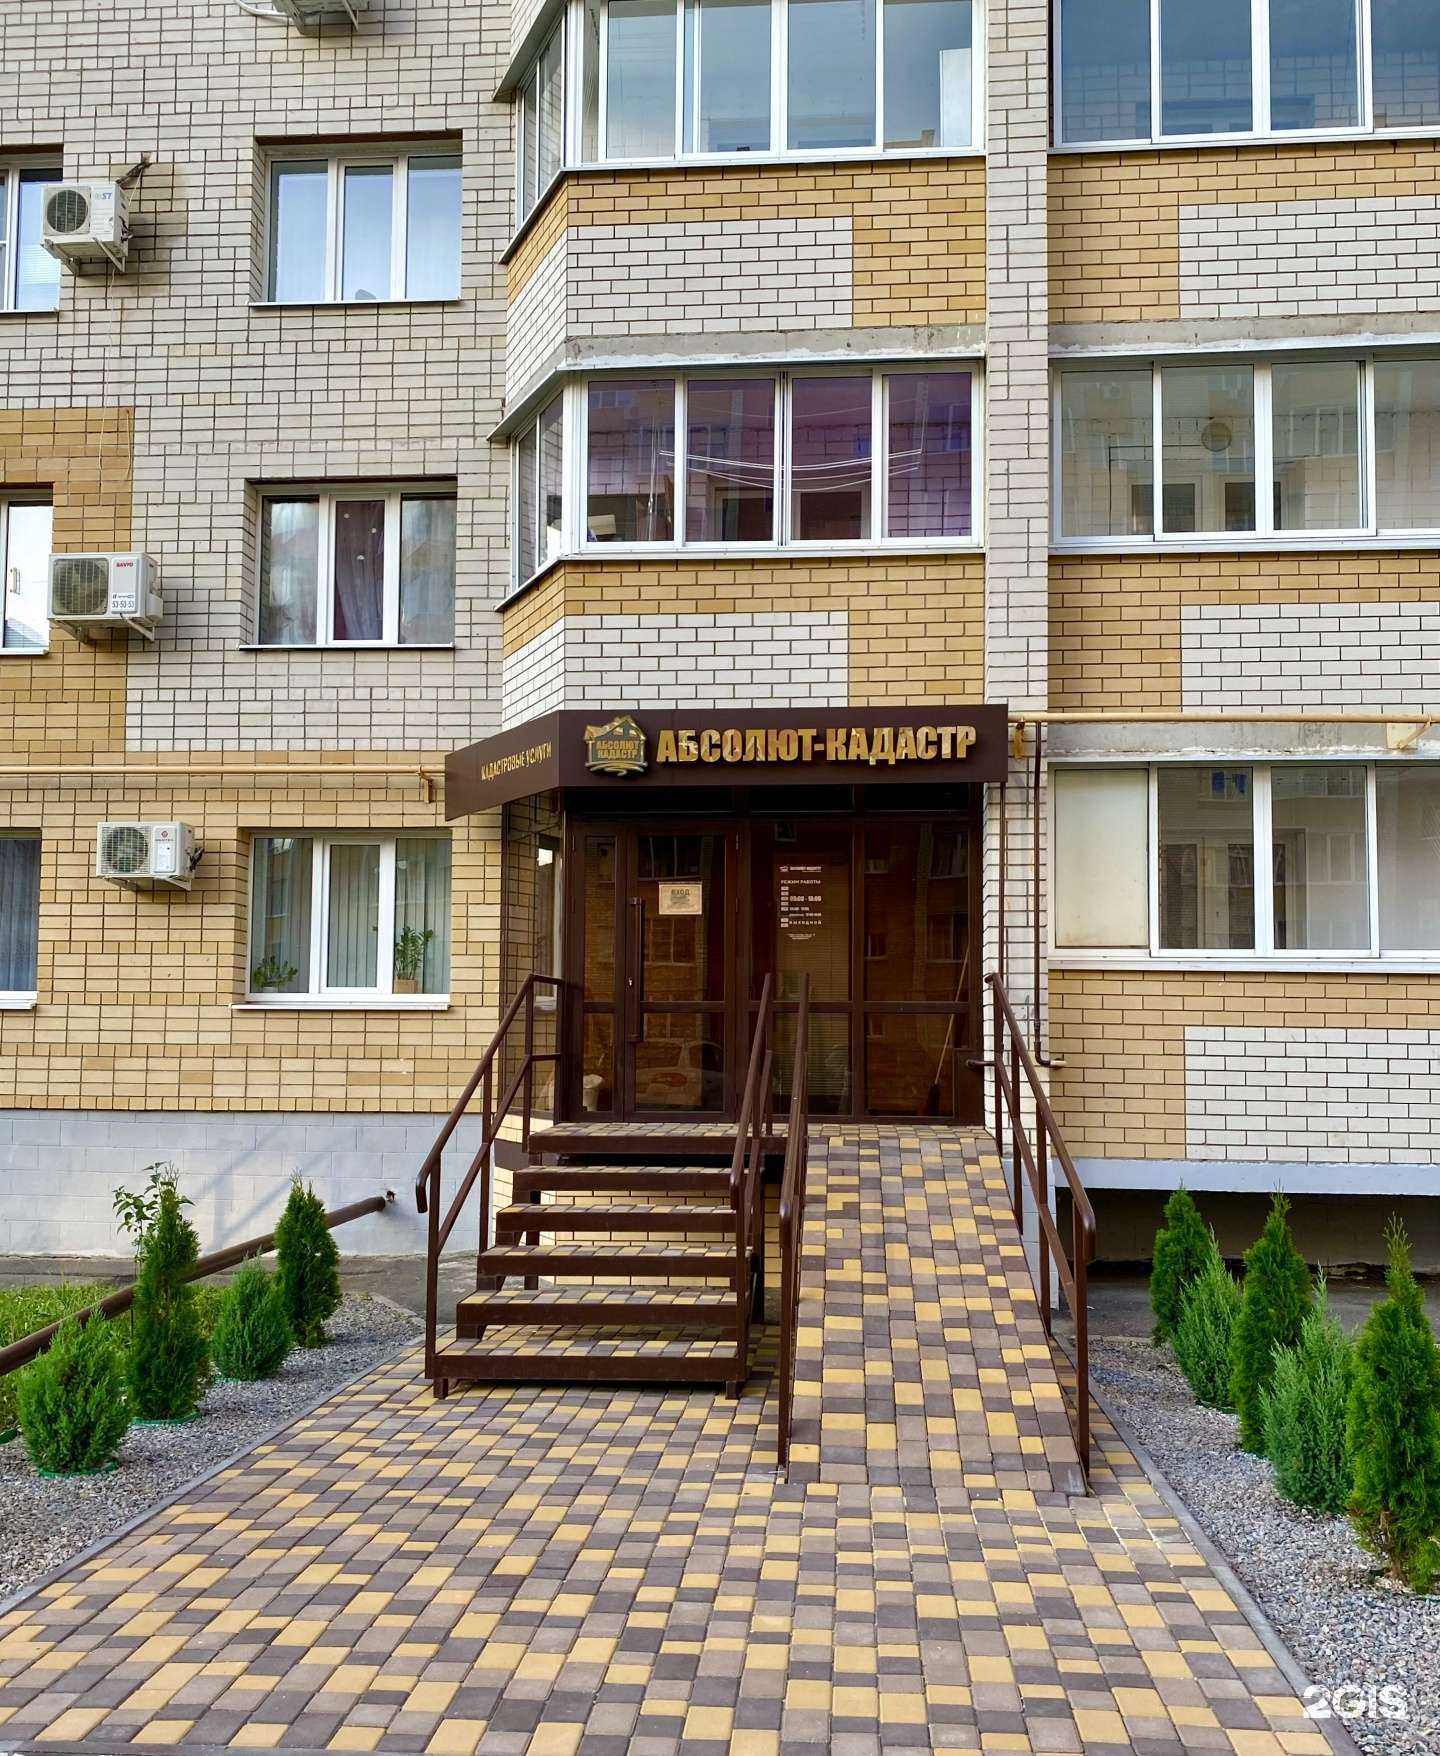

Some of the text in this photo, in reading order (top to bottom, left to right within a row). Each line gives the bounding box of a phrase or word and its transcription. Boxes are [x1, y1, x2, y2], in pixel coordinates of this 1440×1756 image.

[481, 741, 552, 781] КАДАСТРОВЫЕ УСЛУГИ
[596, 740, 640, 750] АБСОЛЮТ
[656, 725, 977, 765] АБСОЛЮТ-КАДАСТР
